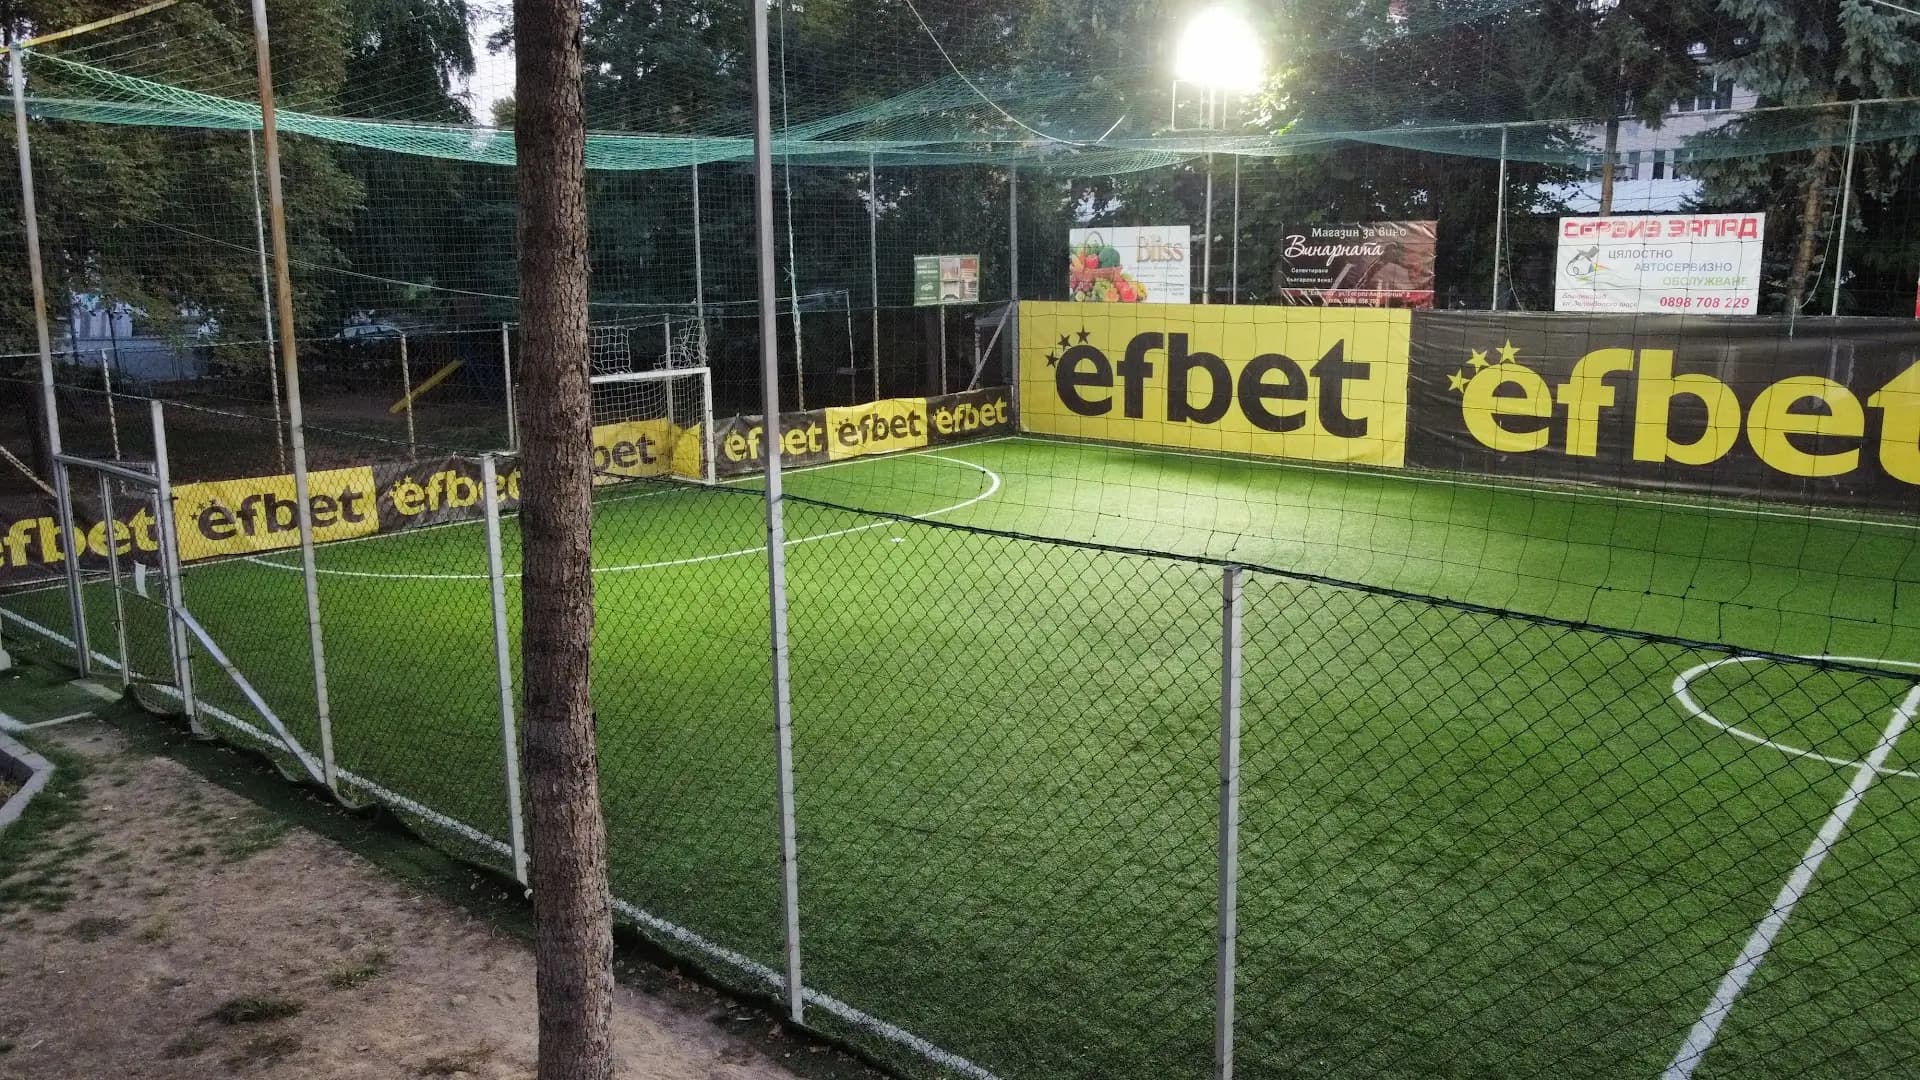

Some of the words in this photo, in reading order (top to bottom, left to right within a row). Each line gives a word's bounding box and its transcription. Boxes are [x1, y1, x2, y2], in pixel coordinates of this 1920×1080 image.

[1312, 228, 1360, 239] Магазин
[1363, 229, 1376, 239] за
[1668, 218, 1758, 239] ЗАПАД
[1284, 235, 1385, 266] Винарната
[1608, 249, 1673, 260] ЦЯЛОСТНО
[1633, 262, 1733, 272] АВТОСЕРВИЗНО
[1660, 296, 1692, 308] 0898
[1696, 297, 1721, 308] 708
[1724, 297, 1750, 308] 229
[1055, 332, 1371, 438] efbet
[837, 409, 922, 447] efbet
[936, 396, 1008, 434] efbet
[198, 485, 365, 541] efbet
